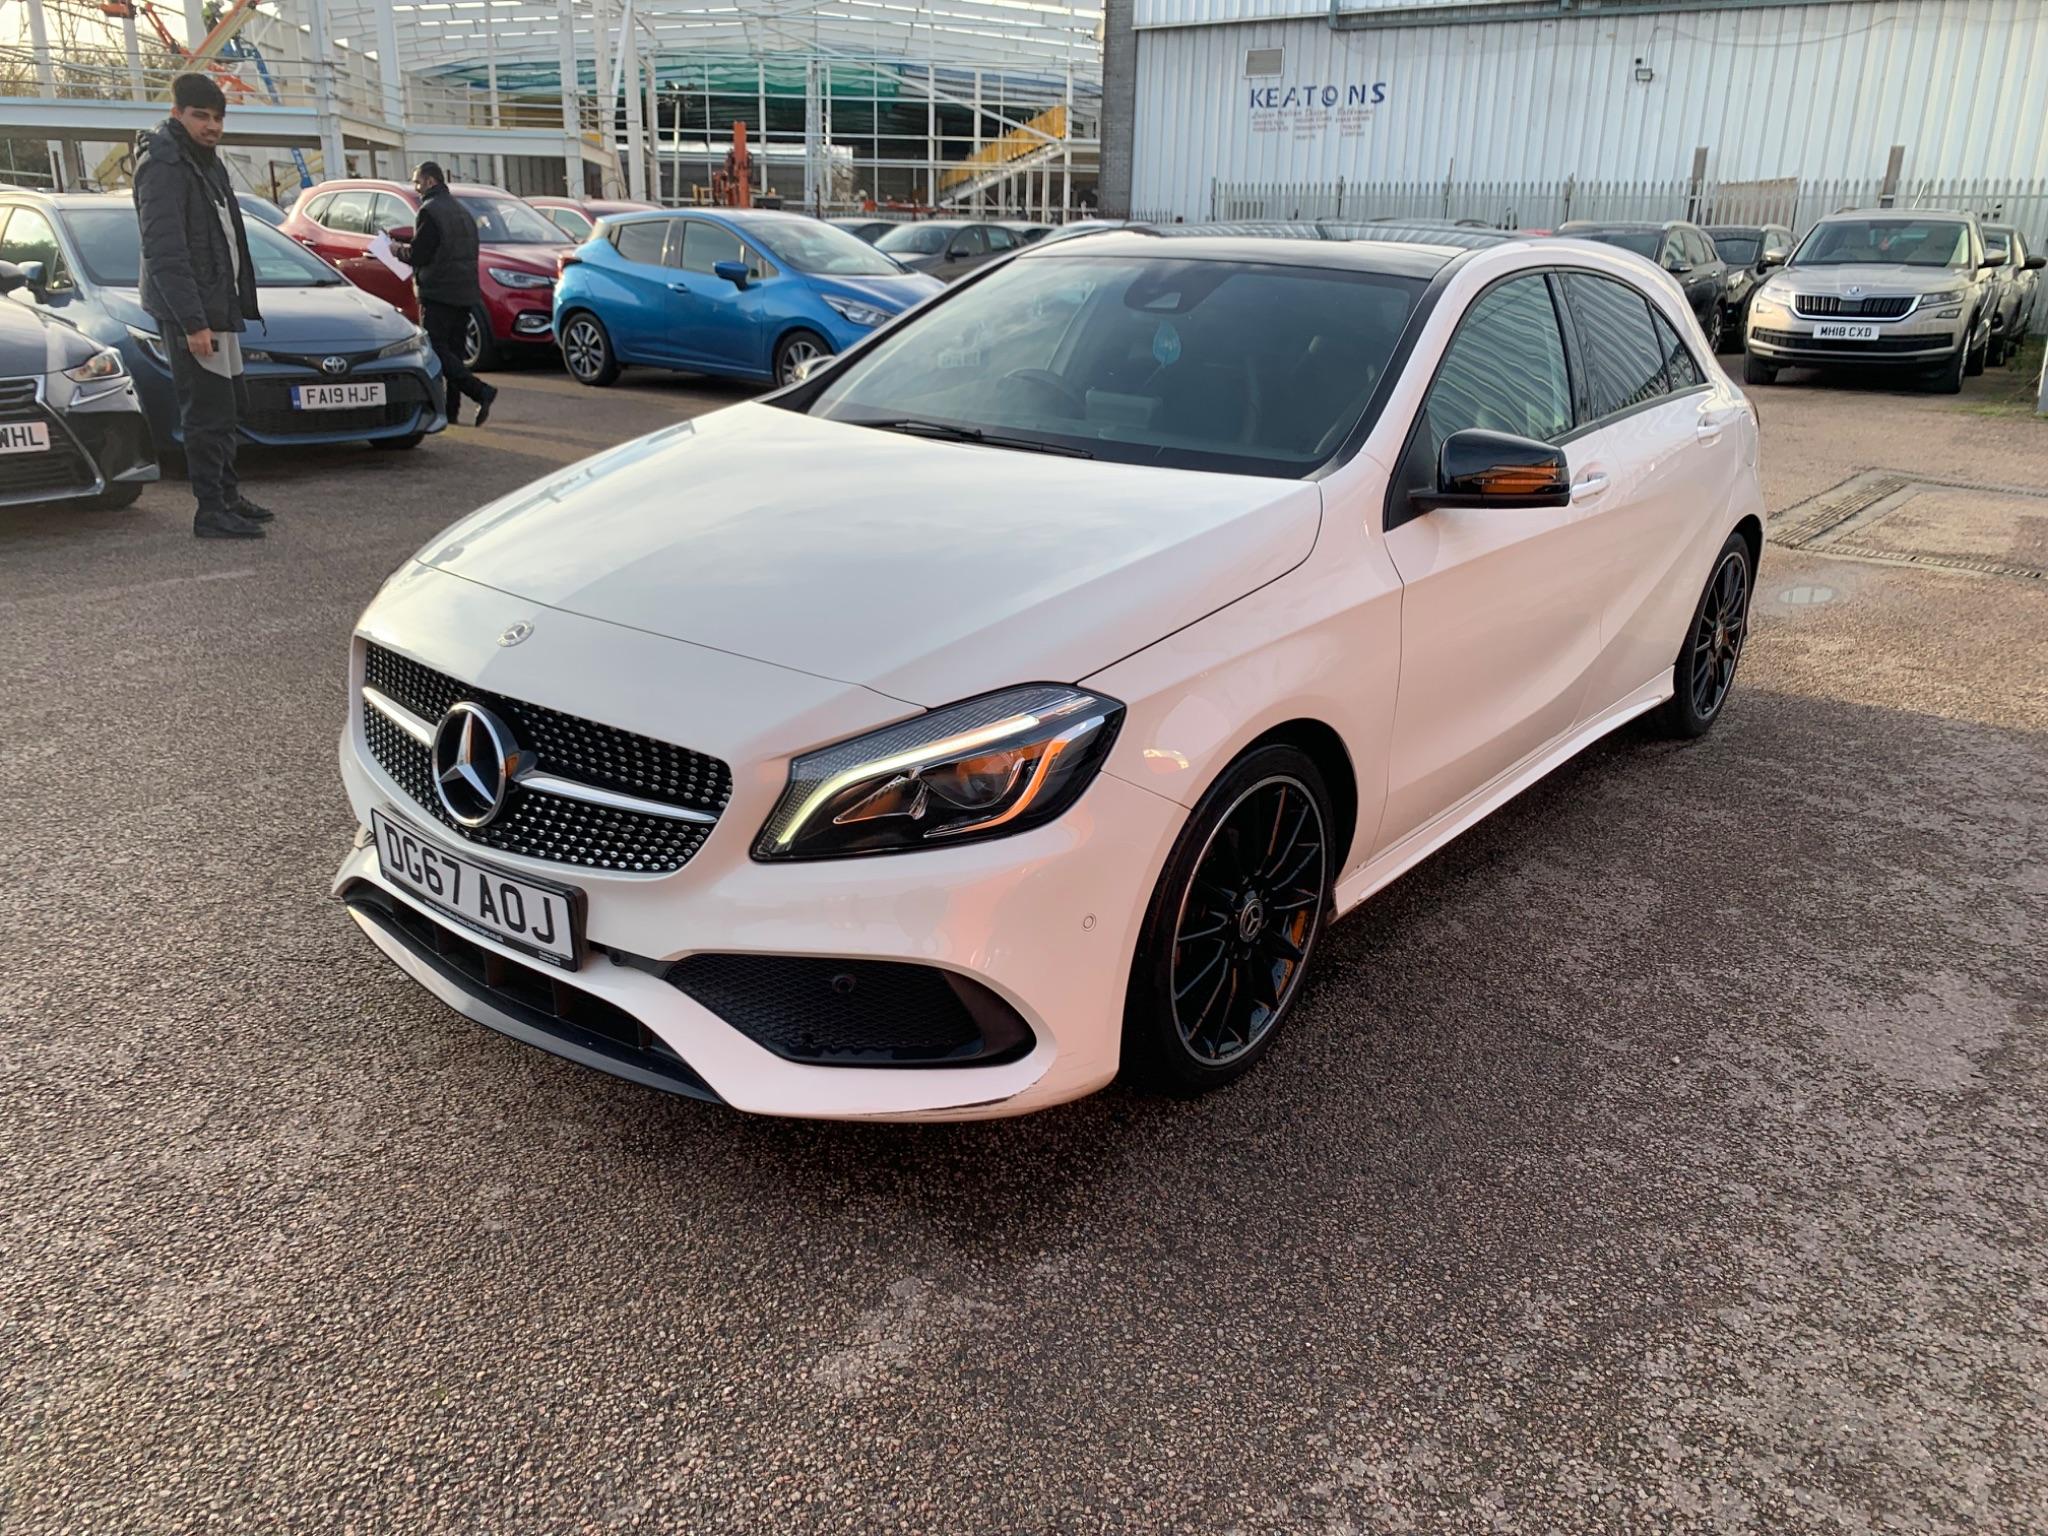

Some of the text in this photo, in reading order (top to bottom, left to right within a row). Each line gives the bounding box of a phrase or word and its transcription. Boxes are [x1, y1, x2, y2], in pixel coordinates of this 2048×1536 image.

[1250, 82, 1387, 109] KEATONS
[1820, 326, 1872, 338] MH18 CXD
[306, 386, 379, 405] FA19 HJF
[384, 822, 461, 906] DG67
[479, 873, 555, 945] AOJ
